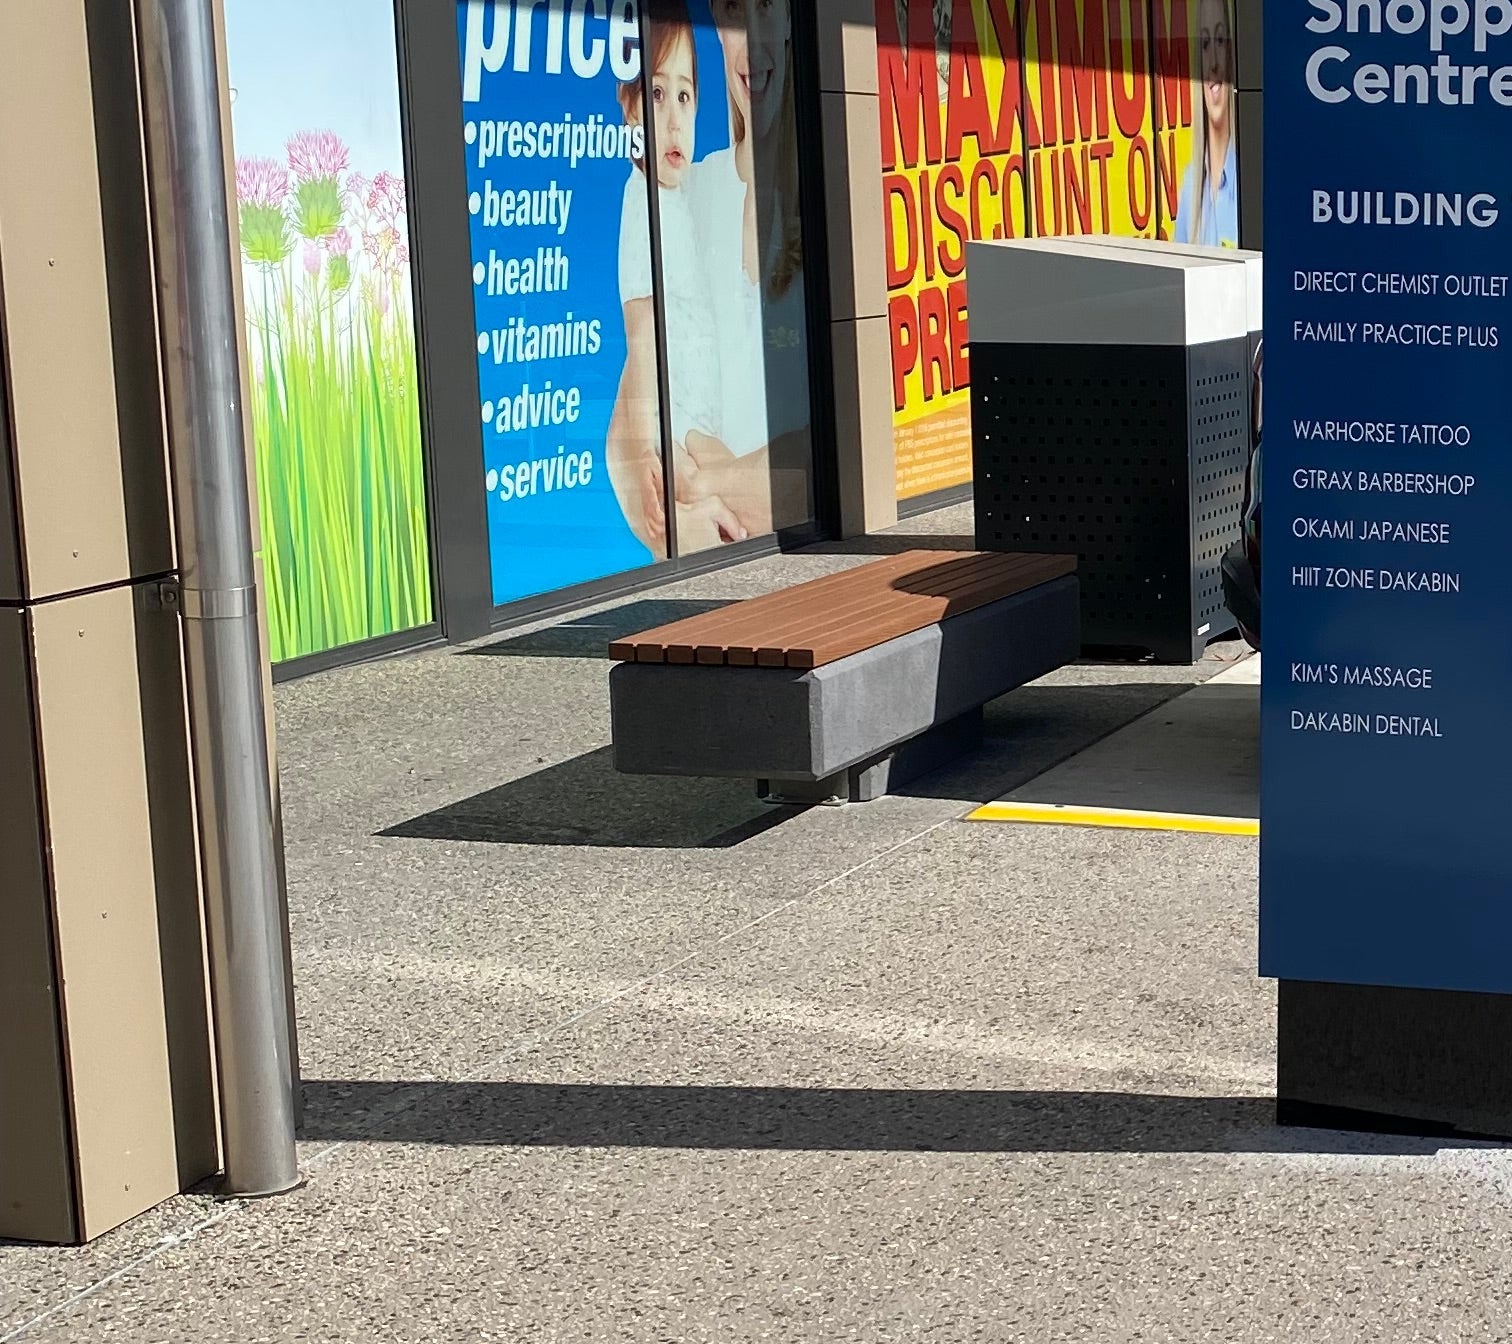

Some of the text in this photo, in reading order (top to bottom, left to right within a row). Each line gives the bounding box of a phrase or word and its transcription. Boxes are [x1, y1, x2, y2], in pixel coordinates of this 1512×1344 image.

[477, 113, 645, 169] prescriptions
[482, 179, 573, 235] beauty
[882, 132, 1178, 291] DISCOUNT ON
[1312, 190, 1499, 228] BUILDING
[486, 246, 569, 296] health
[1294, 270, 1509, 297] DIRECT CHEMIST OUTLET
[490, 311, 601, 365] vitamins
[1294, 321, 1499, 347] FAMILY PRACTICE PLUS
[495, 380, 580, 433] advice
[1293, 420, 1471, 446] WARHORSE TATTOO
[500, 448, 593, 502] service
[1293, 469, 1475, 495] GTRAX BARBERSHOP
[1292, 517, 1450, 544] OKAMI JAPANESE
[1292, 567, 1460, 593] HIIT ZONE DAKABIN
[1291, 663, 1433, 689] KIM'S MASSAGE
[1291, 711, 1443, 737] DAKABIN DENTAL
